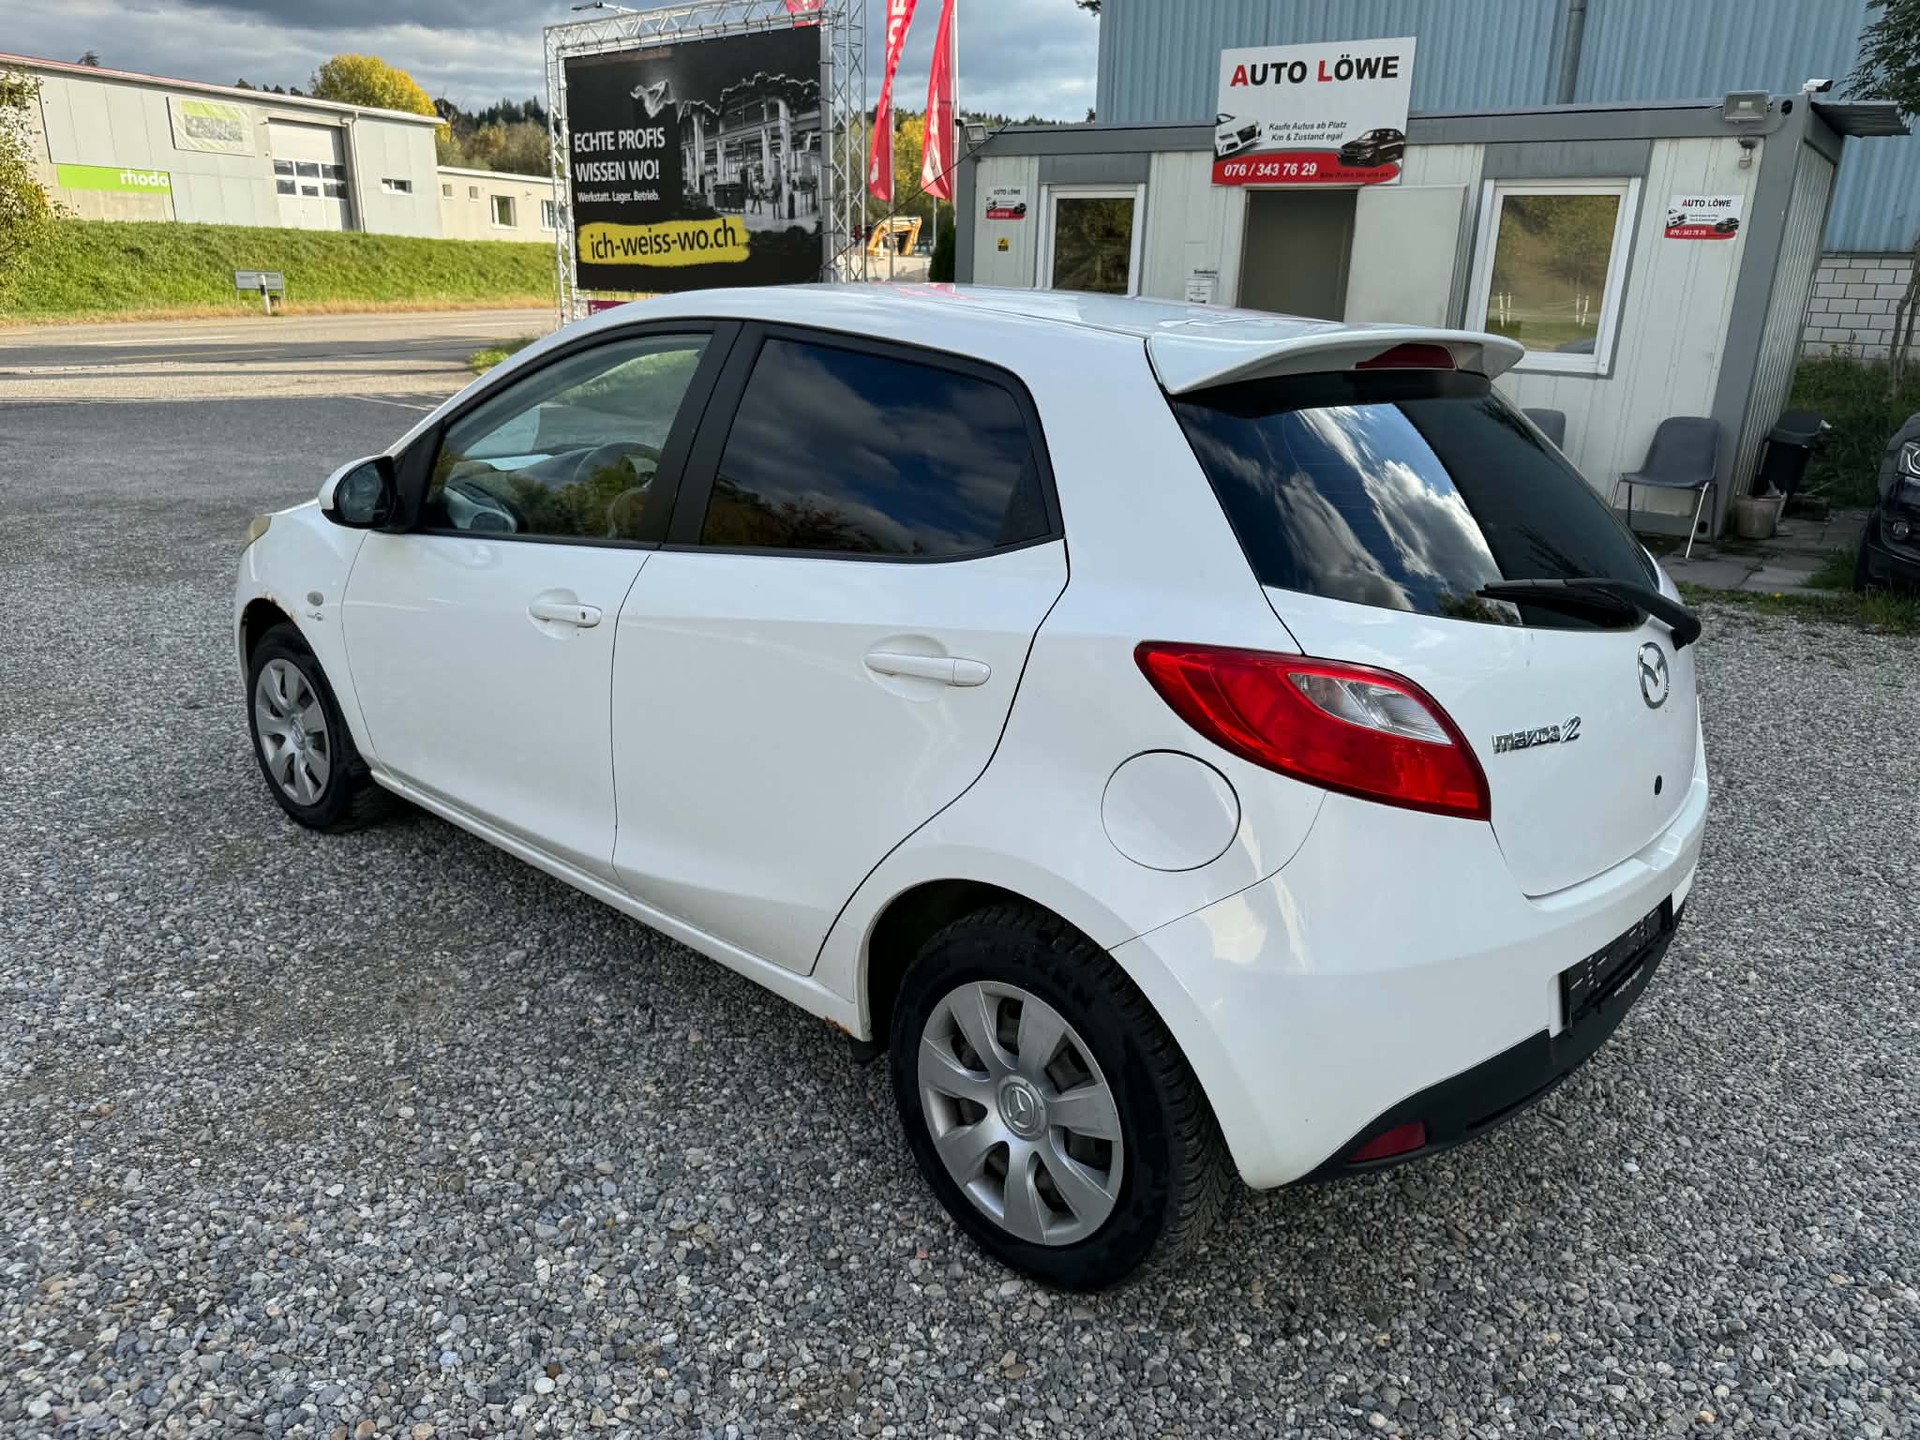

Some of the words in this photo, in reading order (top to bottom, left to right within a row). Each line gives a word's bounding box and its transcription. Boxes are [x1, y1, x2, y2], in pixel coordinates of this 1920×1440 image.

[1230, 61, 1307, 87] AUTO
[1318, 54, 1399, 82] LÖWE
[1268, 122, 1290, 131] Kaufe
[1316, 121, 1326, 129] ab
[1327, 121, 1347, 129] Platz
[574, 131, 615, 153] ECHTE
[618, 127, 665, 150] PROFIS
[1271, 133, 1284, 141] Km
[1285, 133, 1291, 141] &
[1293, 132, 1325, 141] Zustand
[1326, 131, 1343, 141] egal
[575, 161, 625, 182] WISSEN
[629, 159, 660, 180] WO!
[1224, 163, 1246, 177] 076
[1257, 163, 1279, 177] 343
[1283, 163, 1298, 176] 76
[1303, 161, 1317, 175] 29
[120, 169, 169, 187] rhodo
[577, 192, 611, 203] Werkstatt.
[612, 191, 633, 204] Lager.
[633, 190, 660, 201] Betrieb.
[1682, 199, 1706, 207] AUTO
[1708, 198, 1732, 207] LÖWE
[590, 218, 736, 260] ich-weiss-wo.ch
